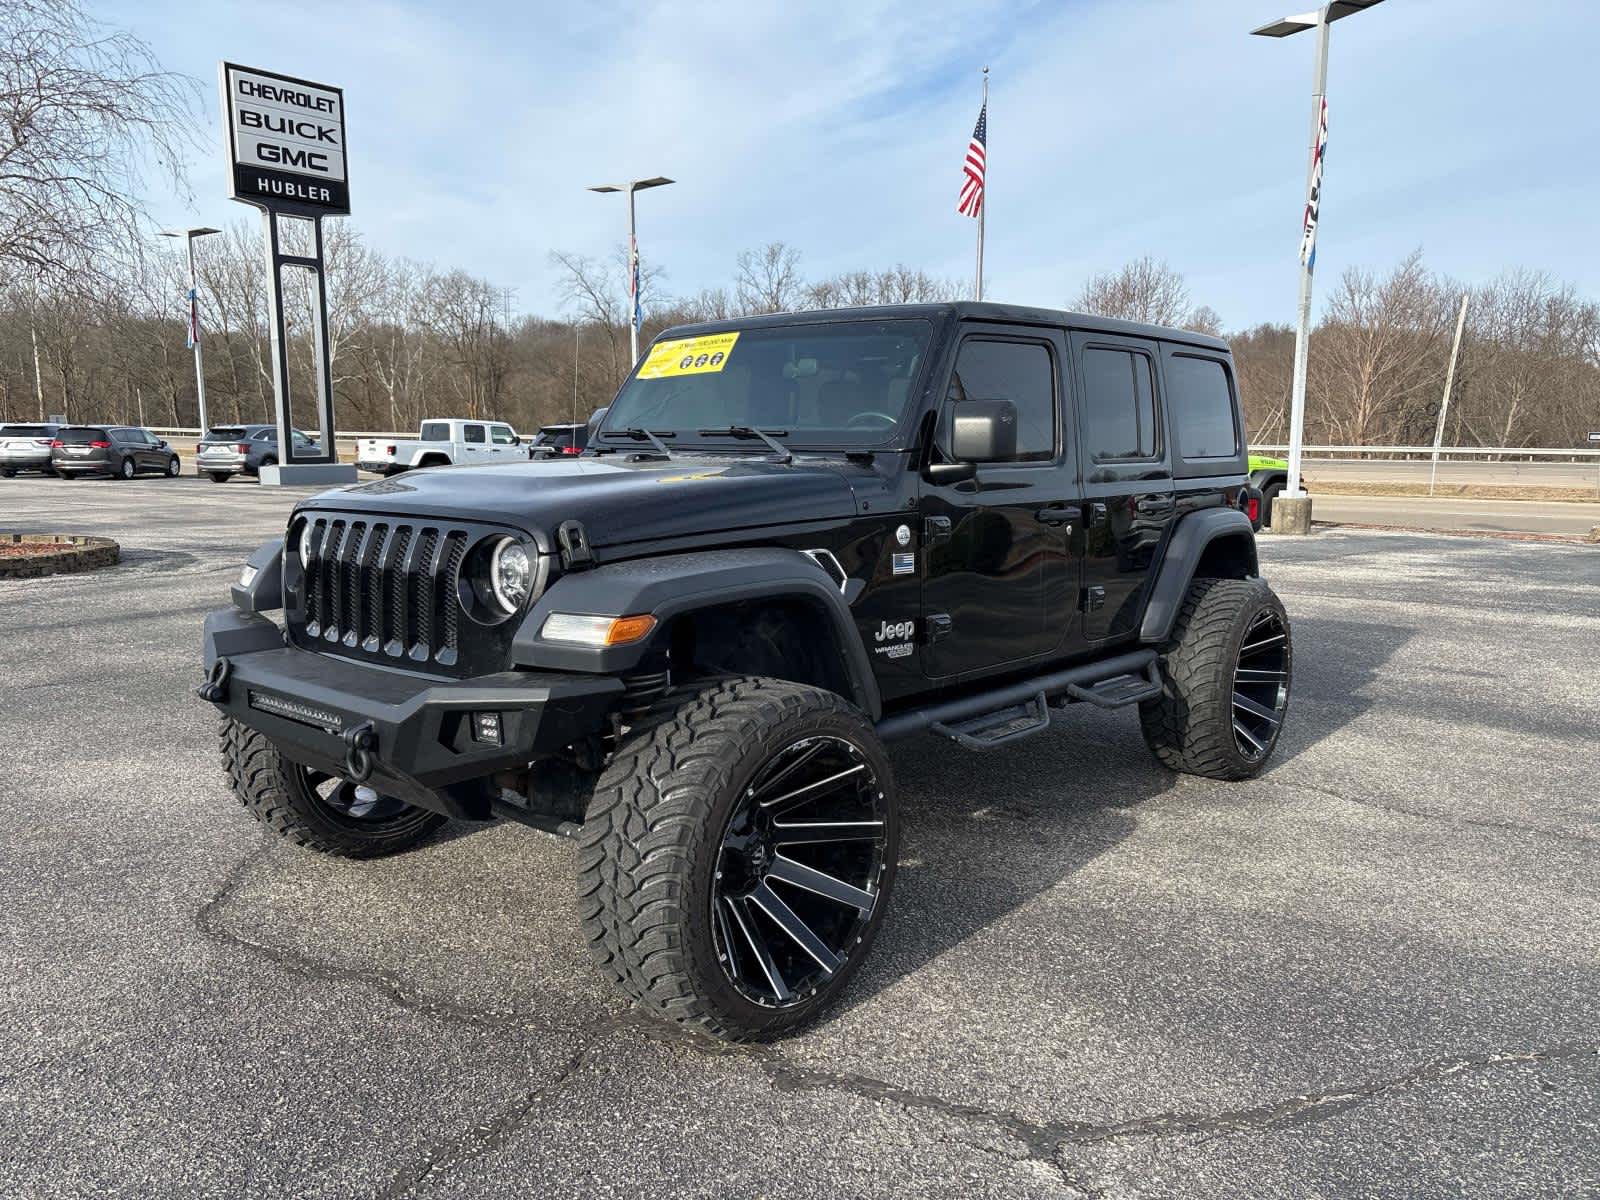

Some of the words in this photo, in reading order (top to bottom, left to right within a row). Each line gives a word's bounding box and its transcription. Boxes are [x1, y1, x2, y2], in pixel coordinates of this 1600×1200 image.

[239, 79, 335, 113] CHEVROLET
[240, 109, 338, 144] BUICK
[256, 142, 328, 172] GMC
[258, 177, 330, 201] HUBLER
[875, 620, 915, 642] Jeep
